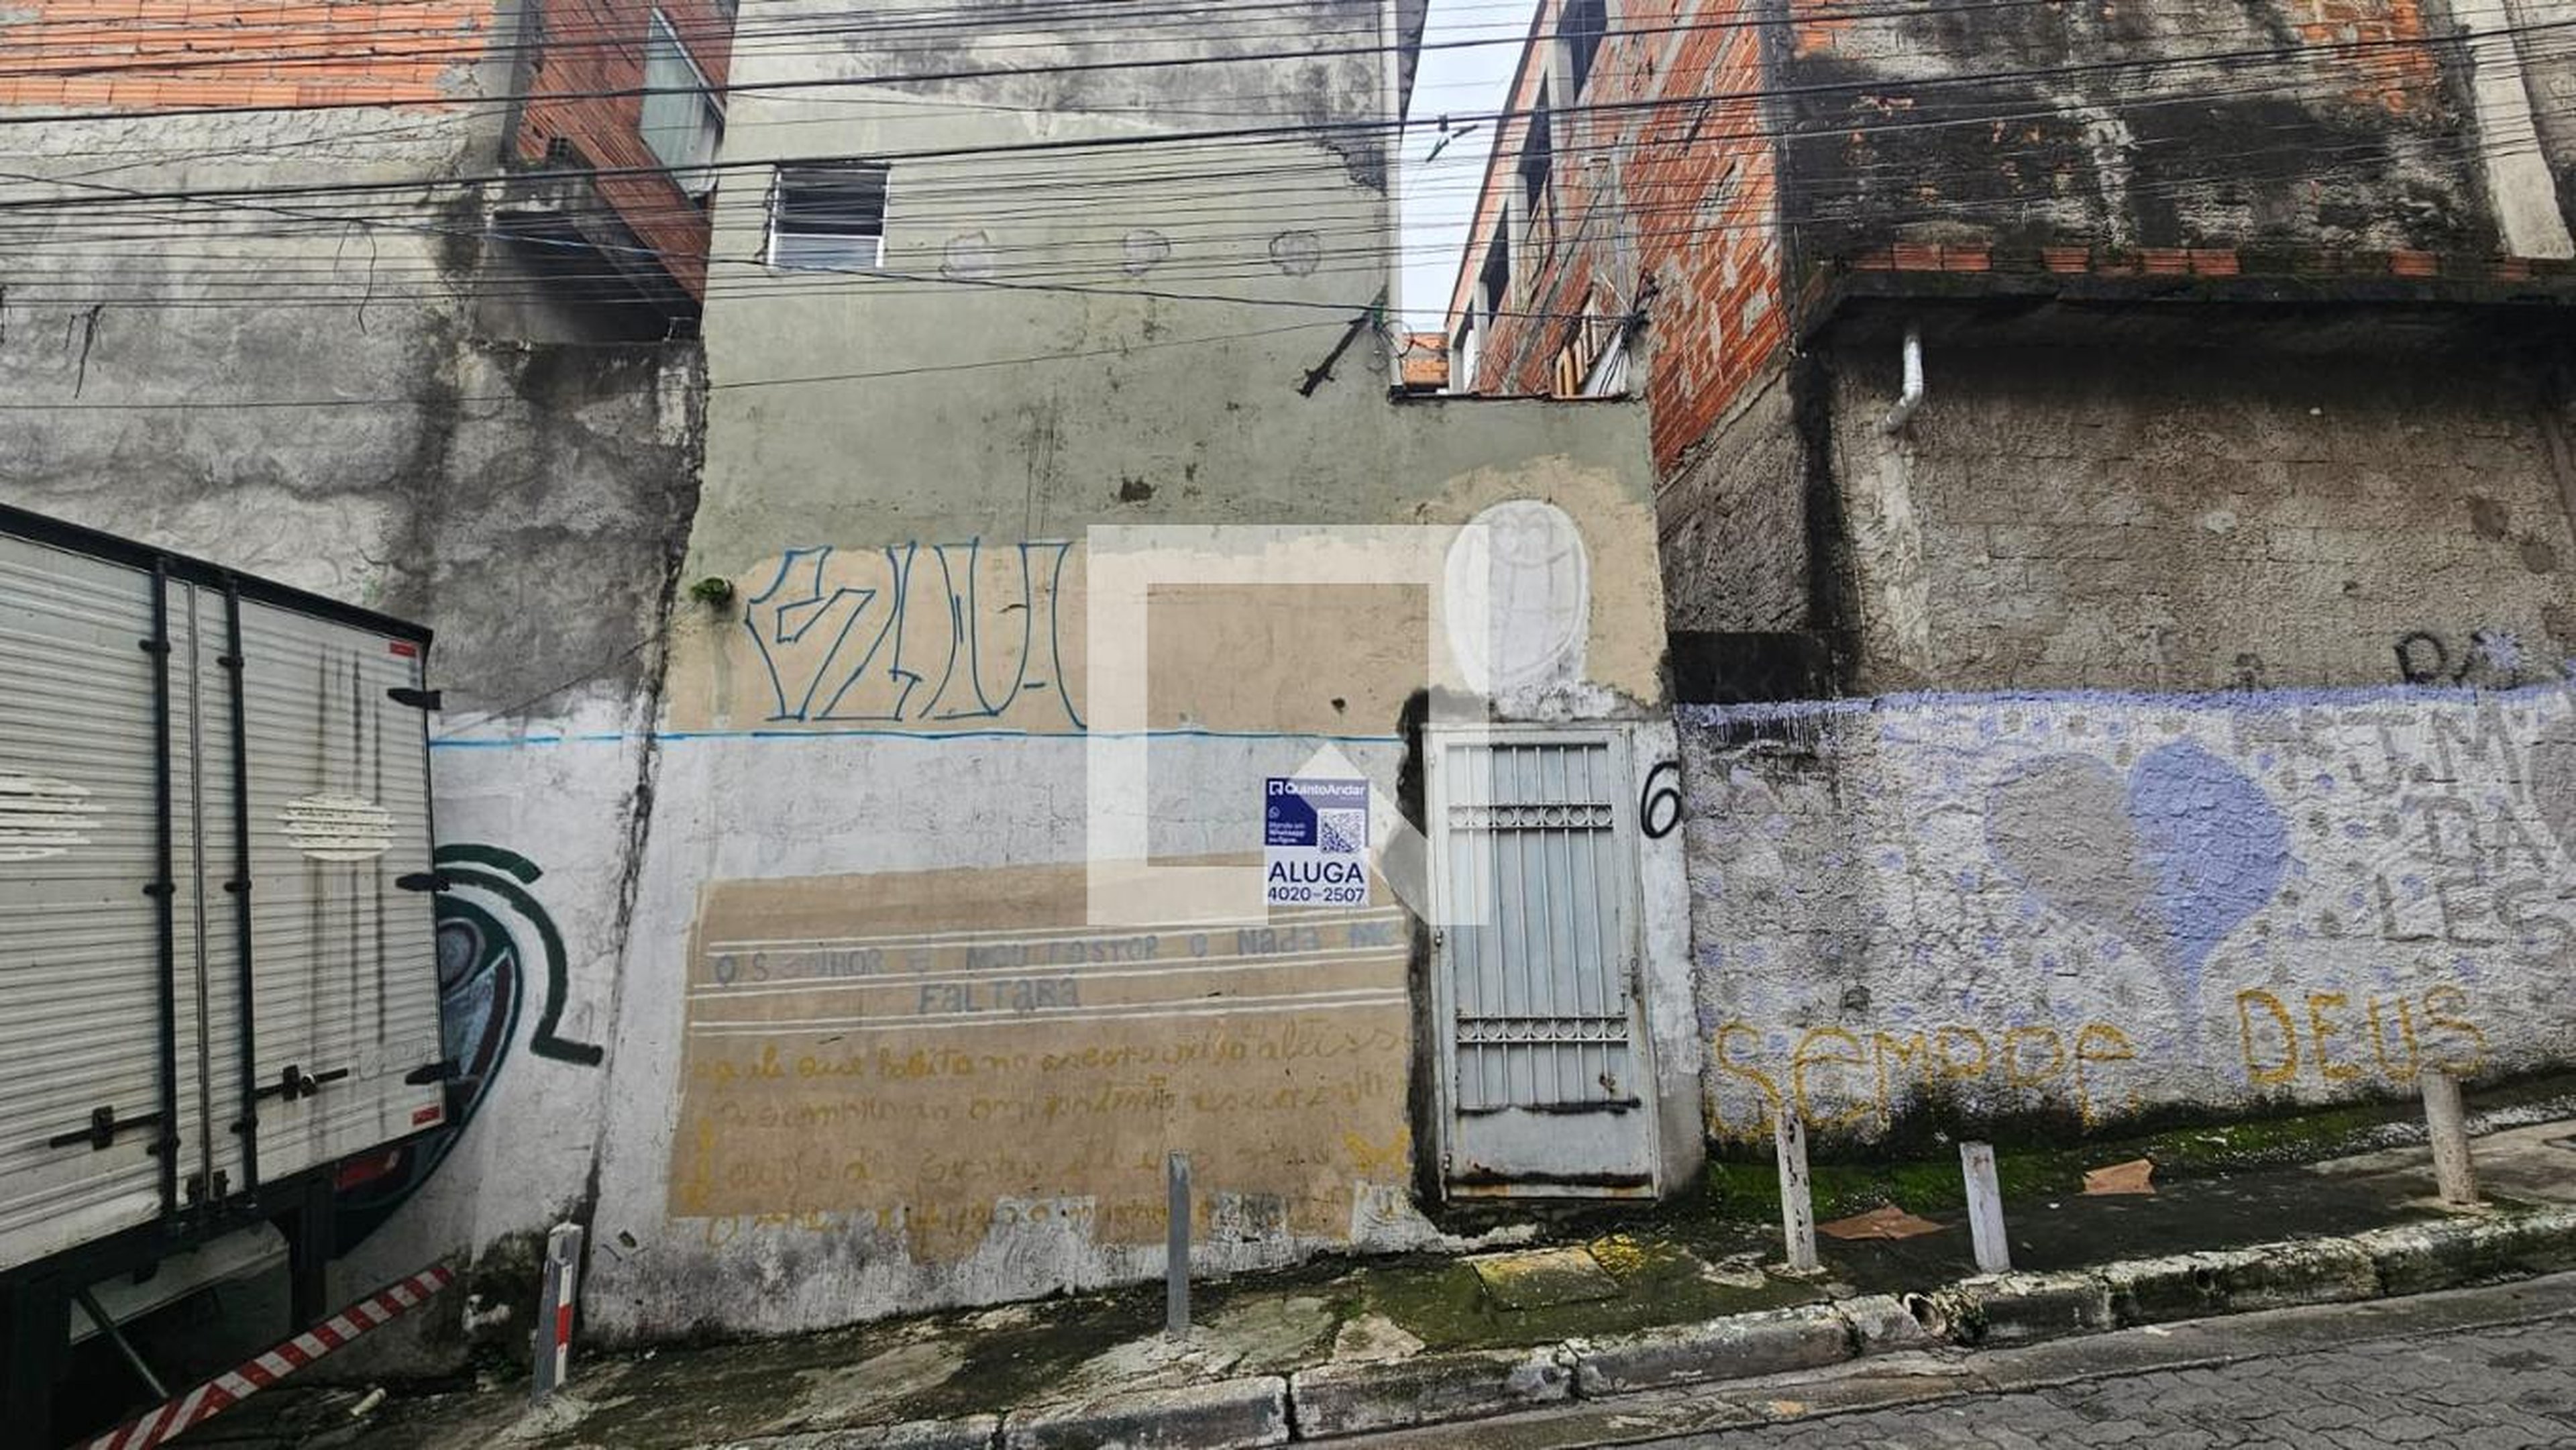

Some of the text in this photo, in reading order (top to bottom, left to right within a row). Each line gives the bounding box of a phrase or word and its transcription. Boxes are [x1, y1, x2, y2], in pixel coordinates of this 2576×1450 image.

[1285, 782, 1366, 796] QuintoAndar
[1640, 760, 1680, 839] 6
[1269, 861, 1364, 884] ALUGA
[1268, 886, 1364, 902] 4020-2507
[2235, 984, 2485, 1082] DEUS
